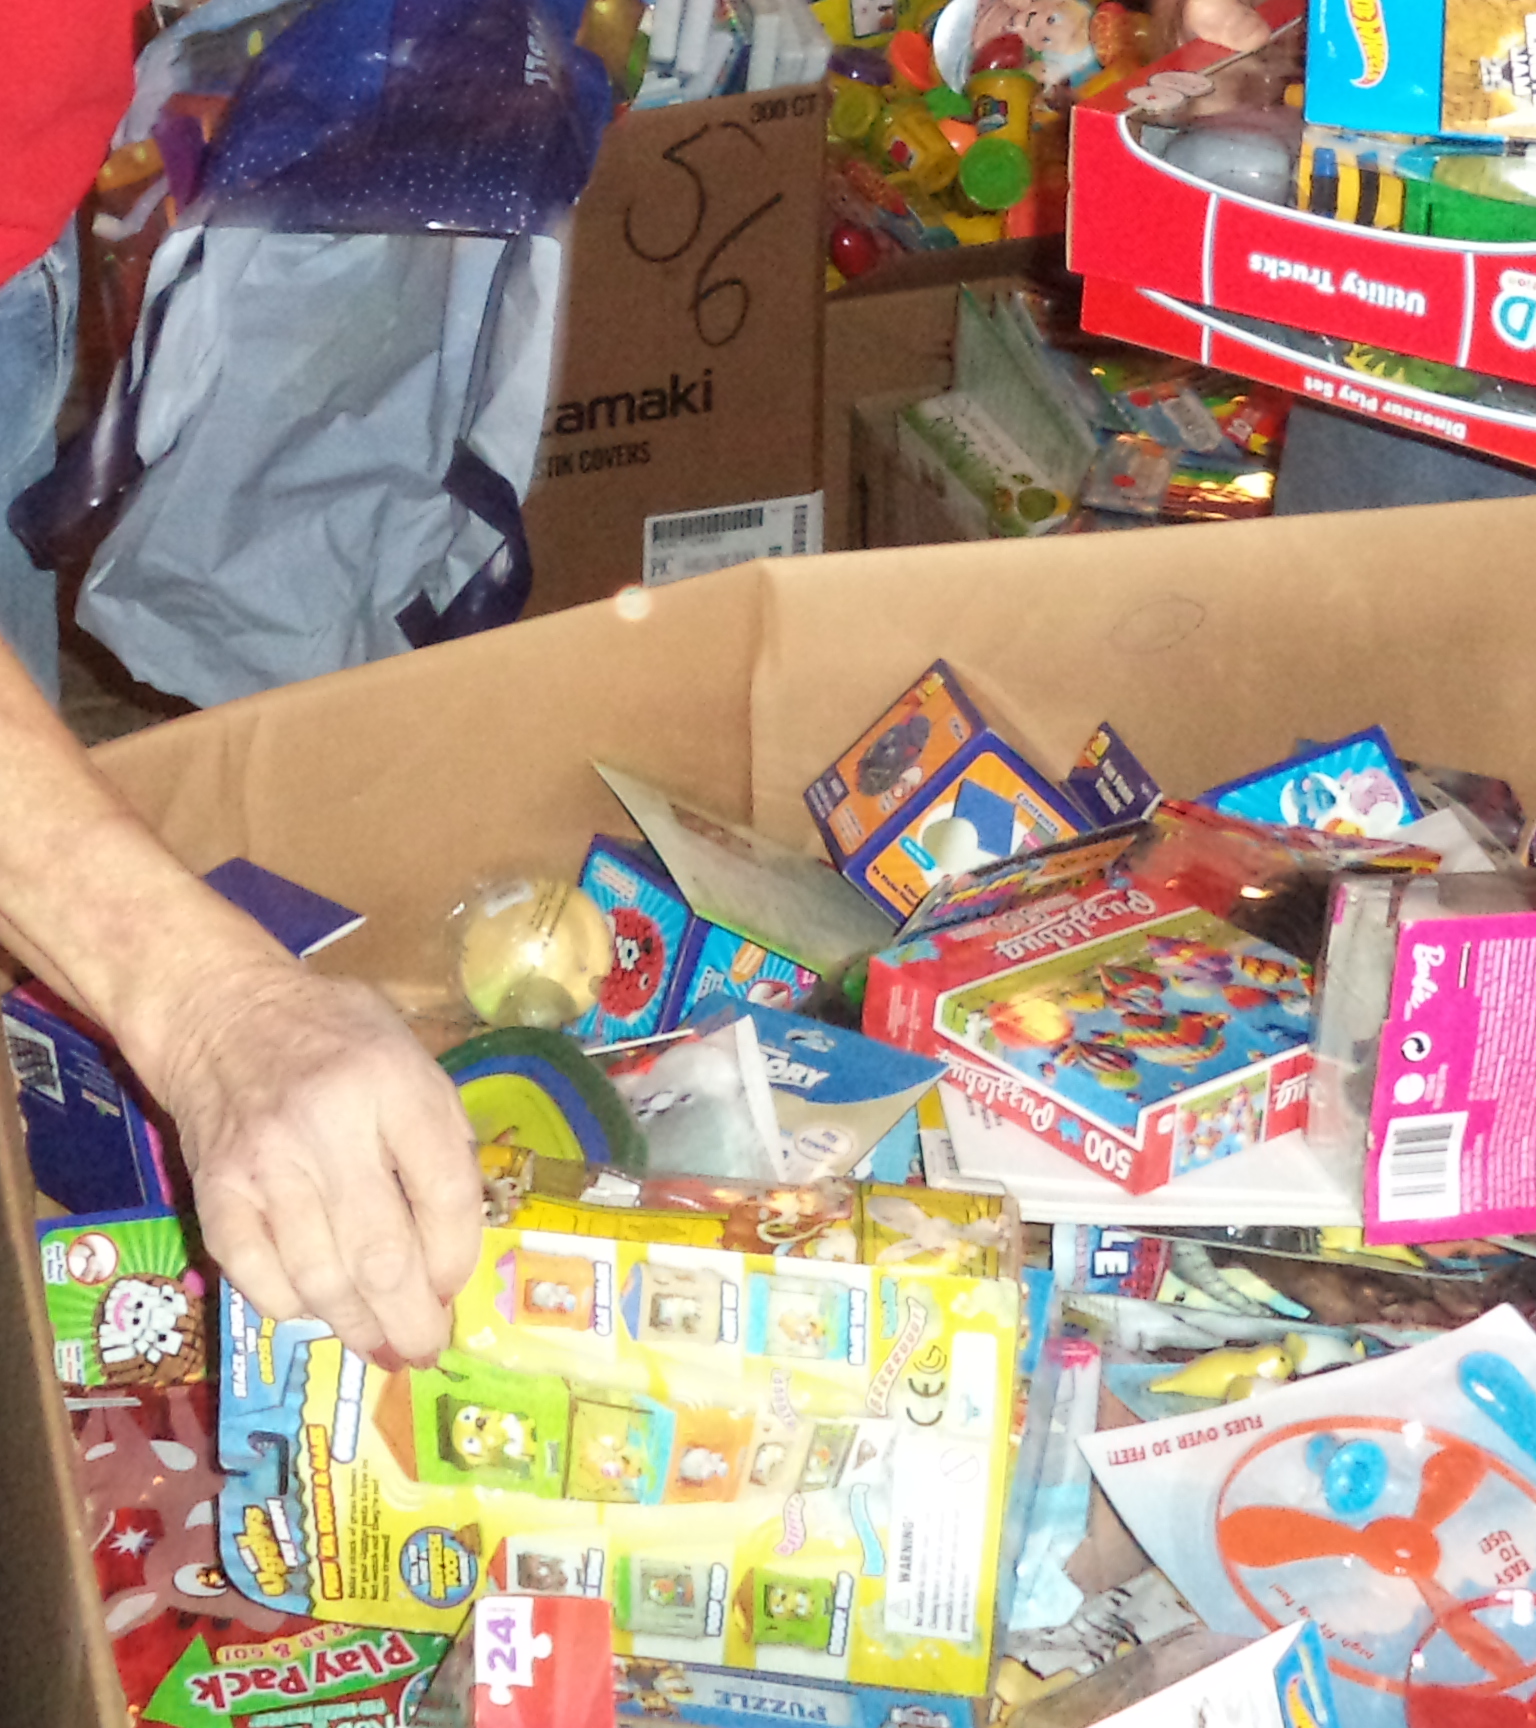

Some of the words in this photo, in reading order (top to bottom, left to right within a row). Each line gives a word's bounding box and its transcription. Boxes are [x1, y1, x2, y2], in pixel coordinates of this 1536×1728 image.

[1509, 47, 1531, 97] JAM
[792, 92, 818, 117] CT
[1248, 252, 1335, 292] Trucks
[1340, 271, 1426, 315] Utility
[1302, 374, 1335, 397] Set
[1336, 383, 1378, 411] Play
[540, 369, 714, 438] amaki
[1381, 399, 1468, 440] Dinosaur
[1083, 1129, 1134, 1181] 500
[1176, 1426, 1217, 1449] OVER
[1223, 1415, 1263, 1437] FLIES
[1106, 1445, 1146, 1466] FEET!
[1152, 1439, 1171, 1457] 30
[1479, 1529, 1512, 1554] USE!
[1498, 1543, 1520, 1561] TO
[1492, 1559, 1531, 1584] EASY
[313, 1631, 417, 1687] Play
[486, 1616, 517, 1673] 24
[188, 1661, 308, 1714] Pack
[712, 1689, 829, 1722] PUZZLE
